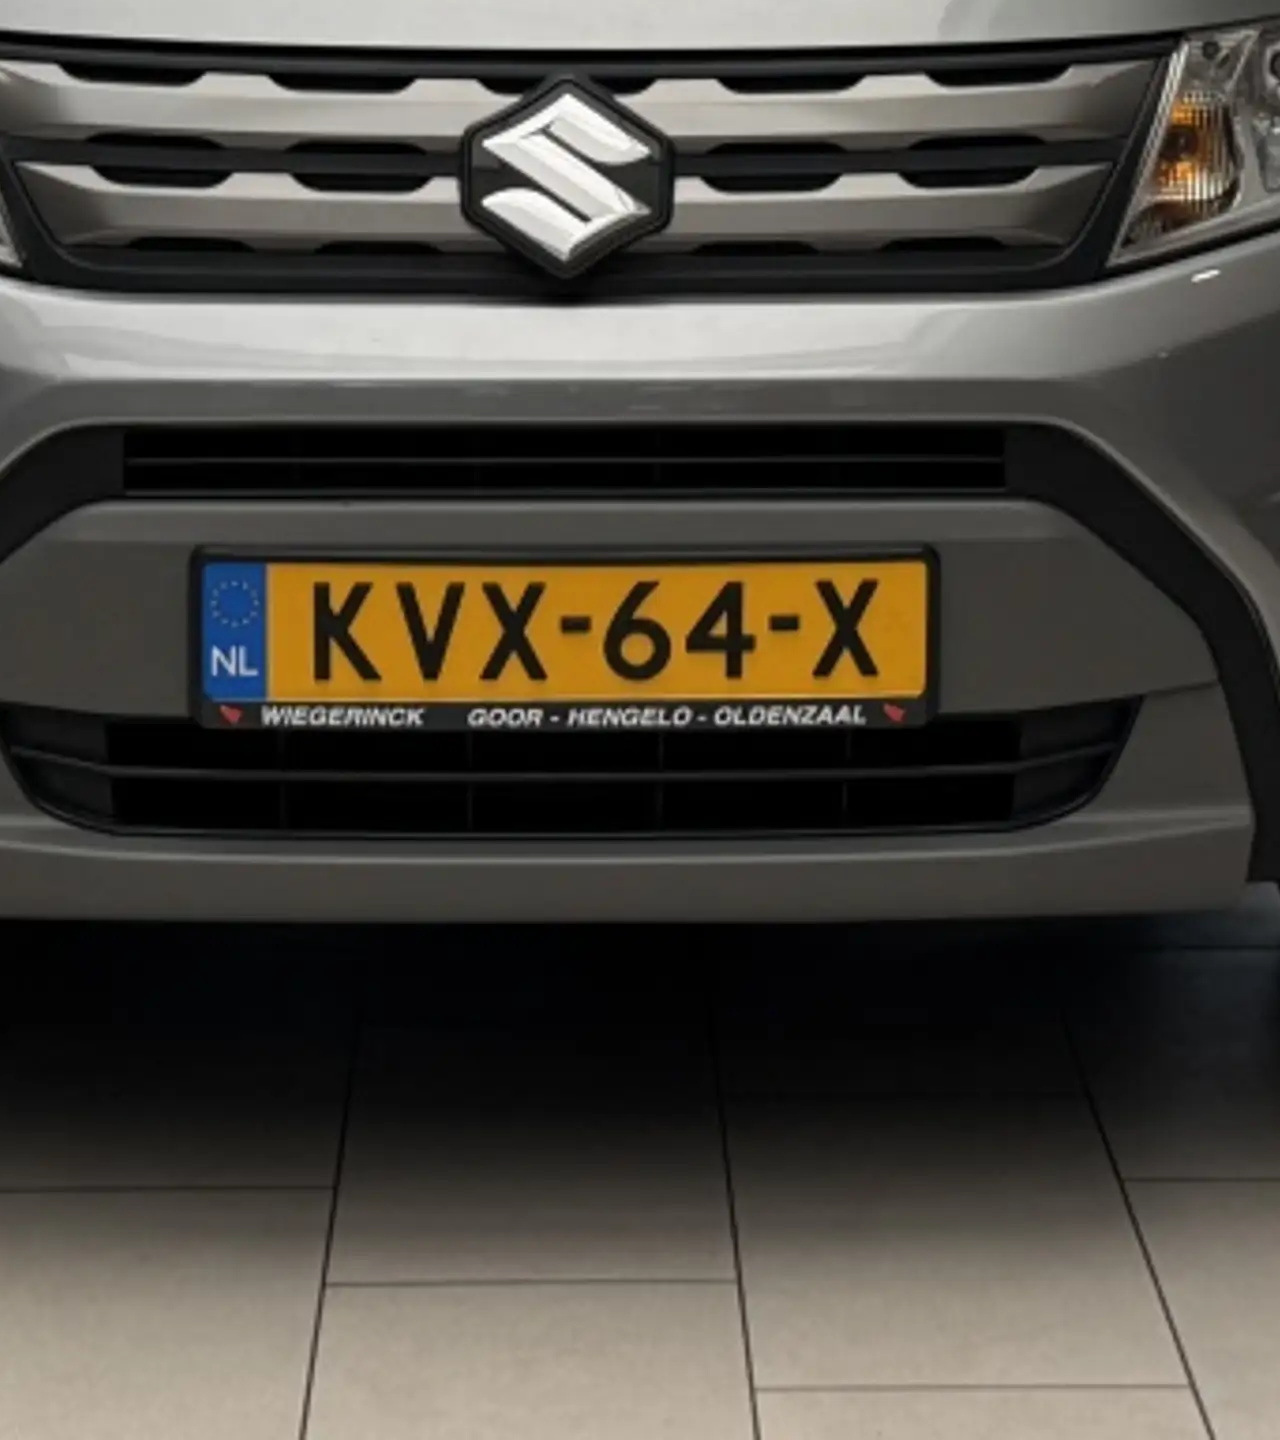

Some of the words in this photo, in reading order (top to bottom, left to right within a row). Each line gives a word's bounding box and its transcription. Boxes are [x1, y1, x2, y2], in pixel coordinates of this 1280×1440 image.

[312, 578, 880, 682] KVX-64-X
[211, 645, 259, 678] NL
[261, 705, 425, 727] WIEGERINCK
[466, 707, 544, 728] GOOR
[567, 706, 693, 727] HENGELO
[714, 704, 868, 727] OLDENZAAL
